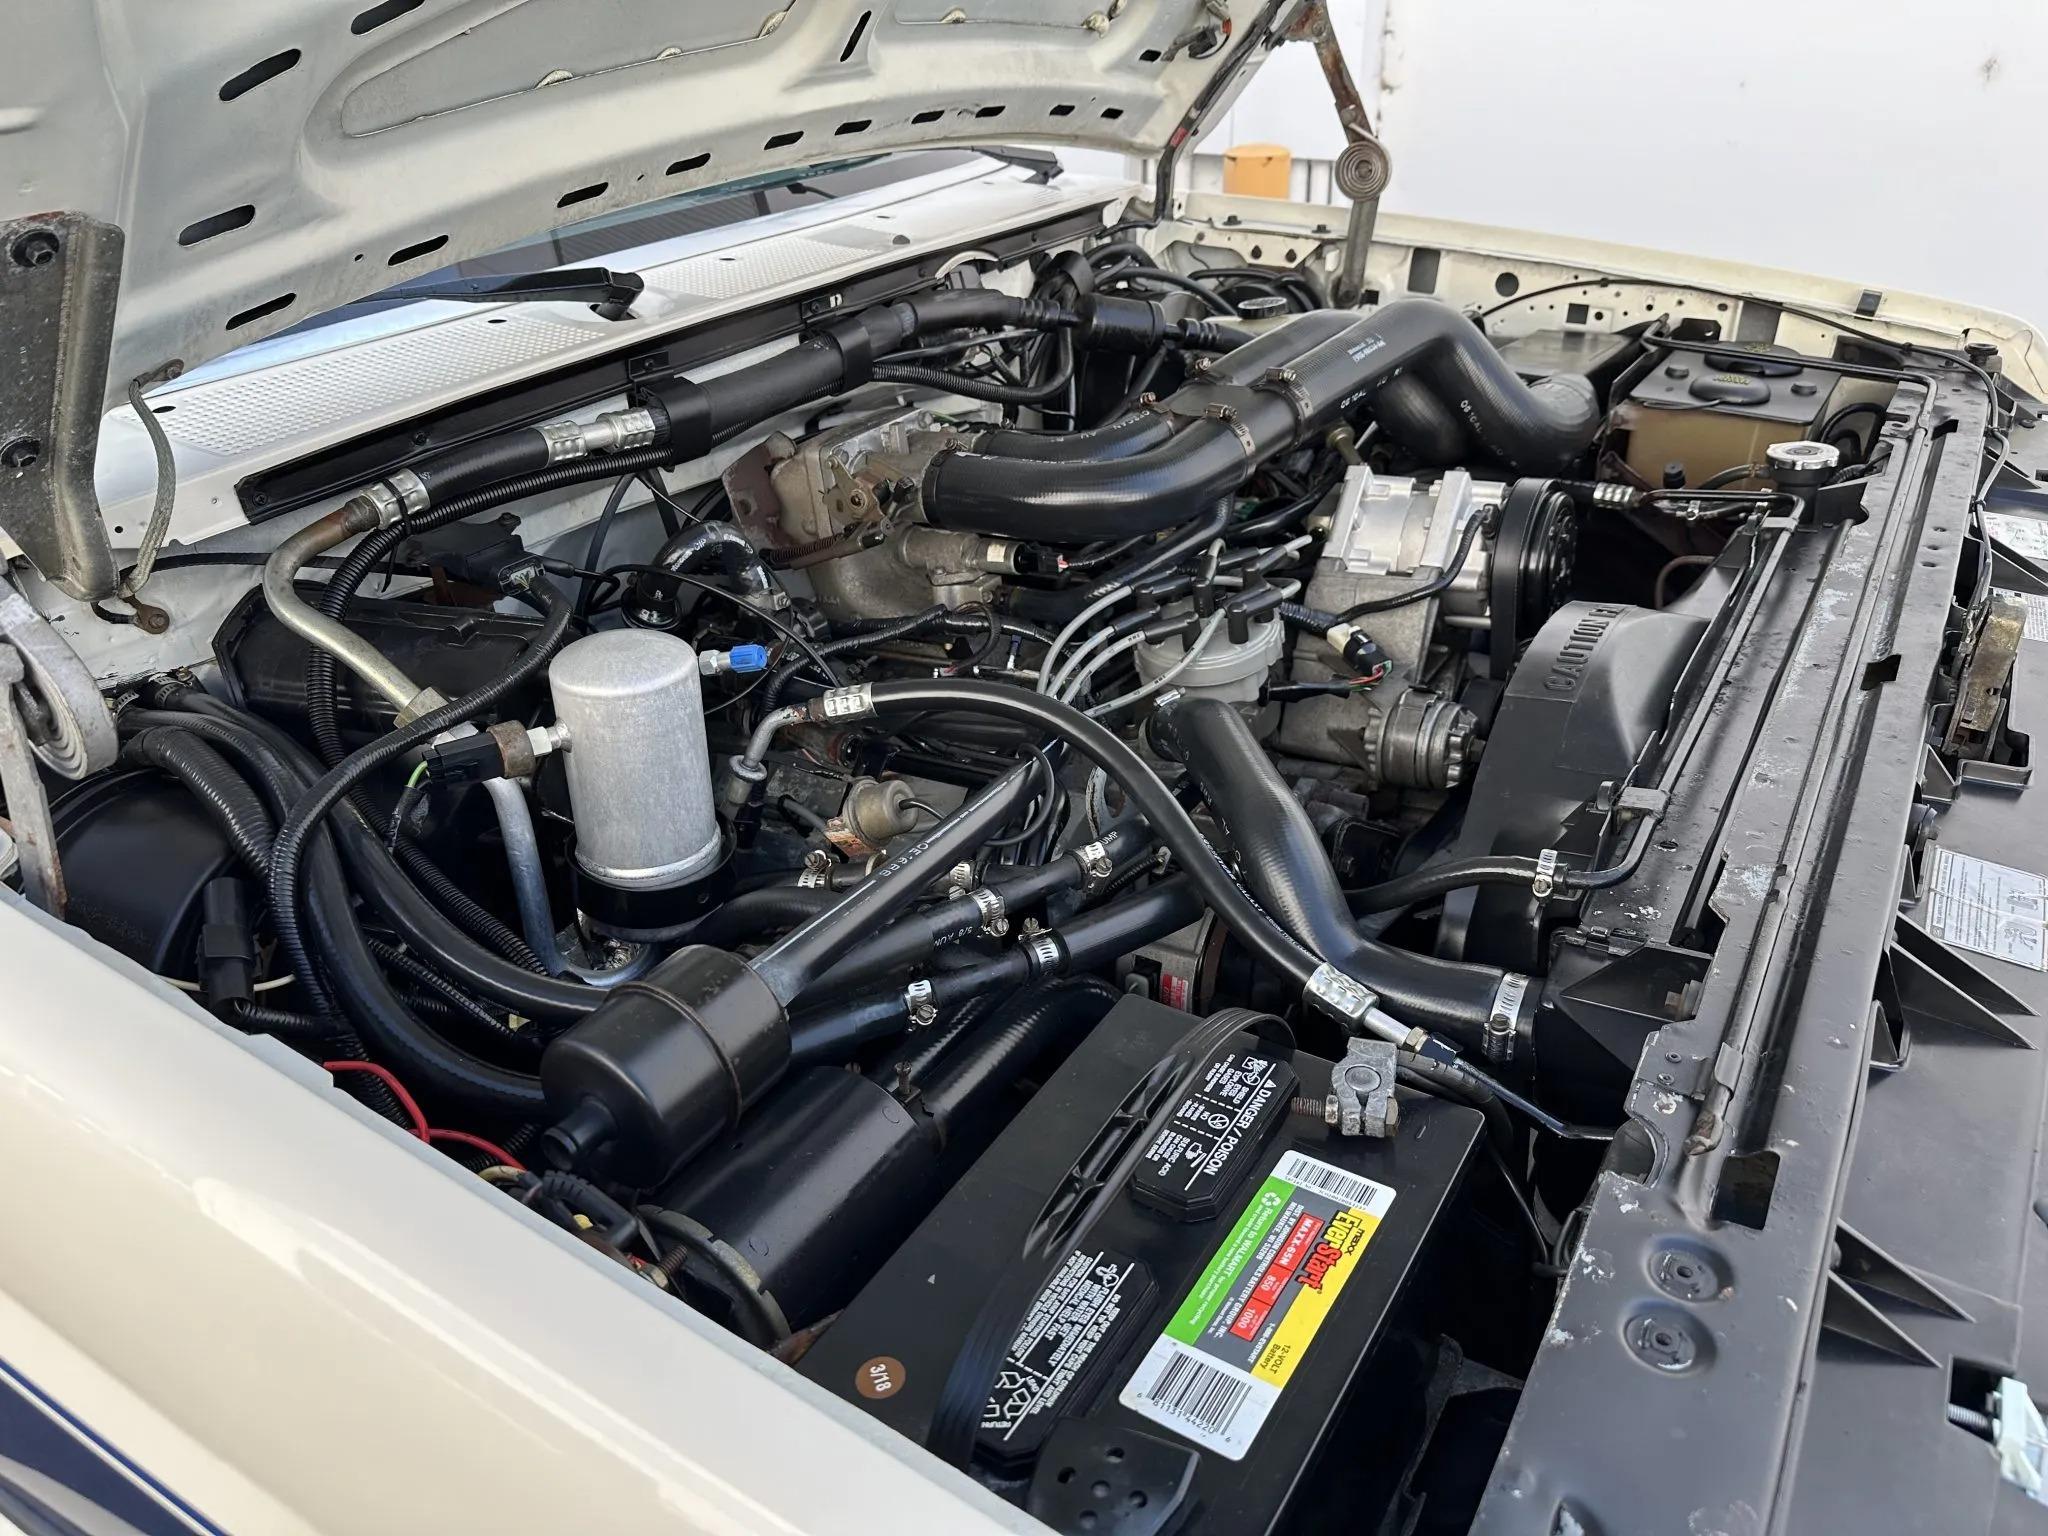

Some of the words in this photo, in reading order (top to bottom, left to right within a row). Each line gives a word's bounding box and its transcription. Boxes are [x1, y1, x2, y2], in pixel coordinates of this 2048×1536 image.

[1544, 619, 1609, 690] CAUTION
[1218, 1070, 1242, 1097] EXPLOSIVE
[1231, 1086, 1249, 1104] SHIELD
[1199, 1110, 1210, 1120] NO
[1235, 1088, 1272, 1129] DANGER
[1166, 1136, 1190, 1163] SULFURIC
[1202, 1135, 1238, 1175] POISON
[1157, 1162, 1172, 1176] ACID
[1251, 1206, 1273, 1231] Return
[1286, 1217, 1296, 1225] BY
[1246, 1230, 1257, 1239] to
[1266, 1234, 1276, 1242] WI
[1271, 1224, 1291, 1249] JOHNSON
[1277, 1217, 1314, 1265] MAXX-65N
[1343, 1228, 1366, 1255] maxx
[1221, 1238, 1252, 1277] WALMART
[1253, 1248, 1276, 1277] CONTROLS
[1293, 1210, 1366, 1292] EverStart
[1068, 1278, 1093, 1306] MEDICAL
[1084, 1282, 1101, 1300] WITH
[1236, 1275, 1259, 1302] BATTERY
[1259, 1274, 1276, 1291] 850
[1089, 1286, 1109, 1308] FLUSH
[1056, 1304, 1074, 1323] HELP
[1077, 1306, 1095, 1325] EYES
[1221, 1301, 1242, 1325] GROUP,
[1235, 1306, 1257, 1329] 1000
[1043, 1321, 1061, 1340] FAST
[1057, 1321, 1072, 1337] GET
[1212, 1324, 1227, 1340] INC.
[1046, 1322, 1083, 1367] IMMEDIATELY
[1258, 1343, 1281, 1369] Battery
[1267, 1343, 1292, 1374] 12-VOLT
[870, 1364, 892, 1392] 3/18
[1152, 1397, 1182, 1418] 81131
[1184, 1413, 1215, 1434] 44220
[1224, 1435, 1231, 1443] 6
